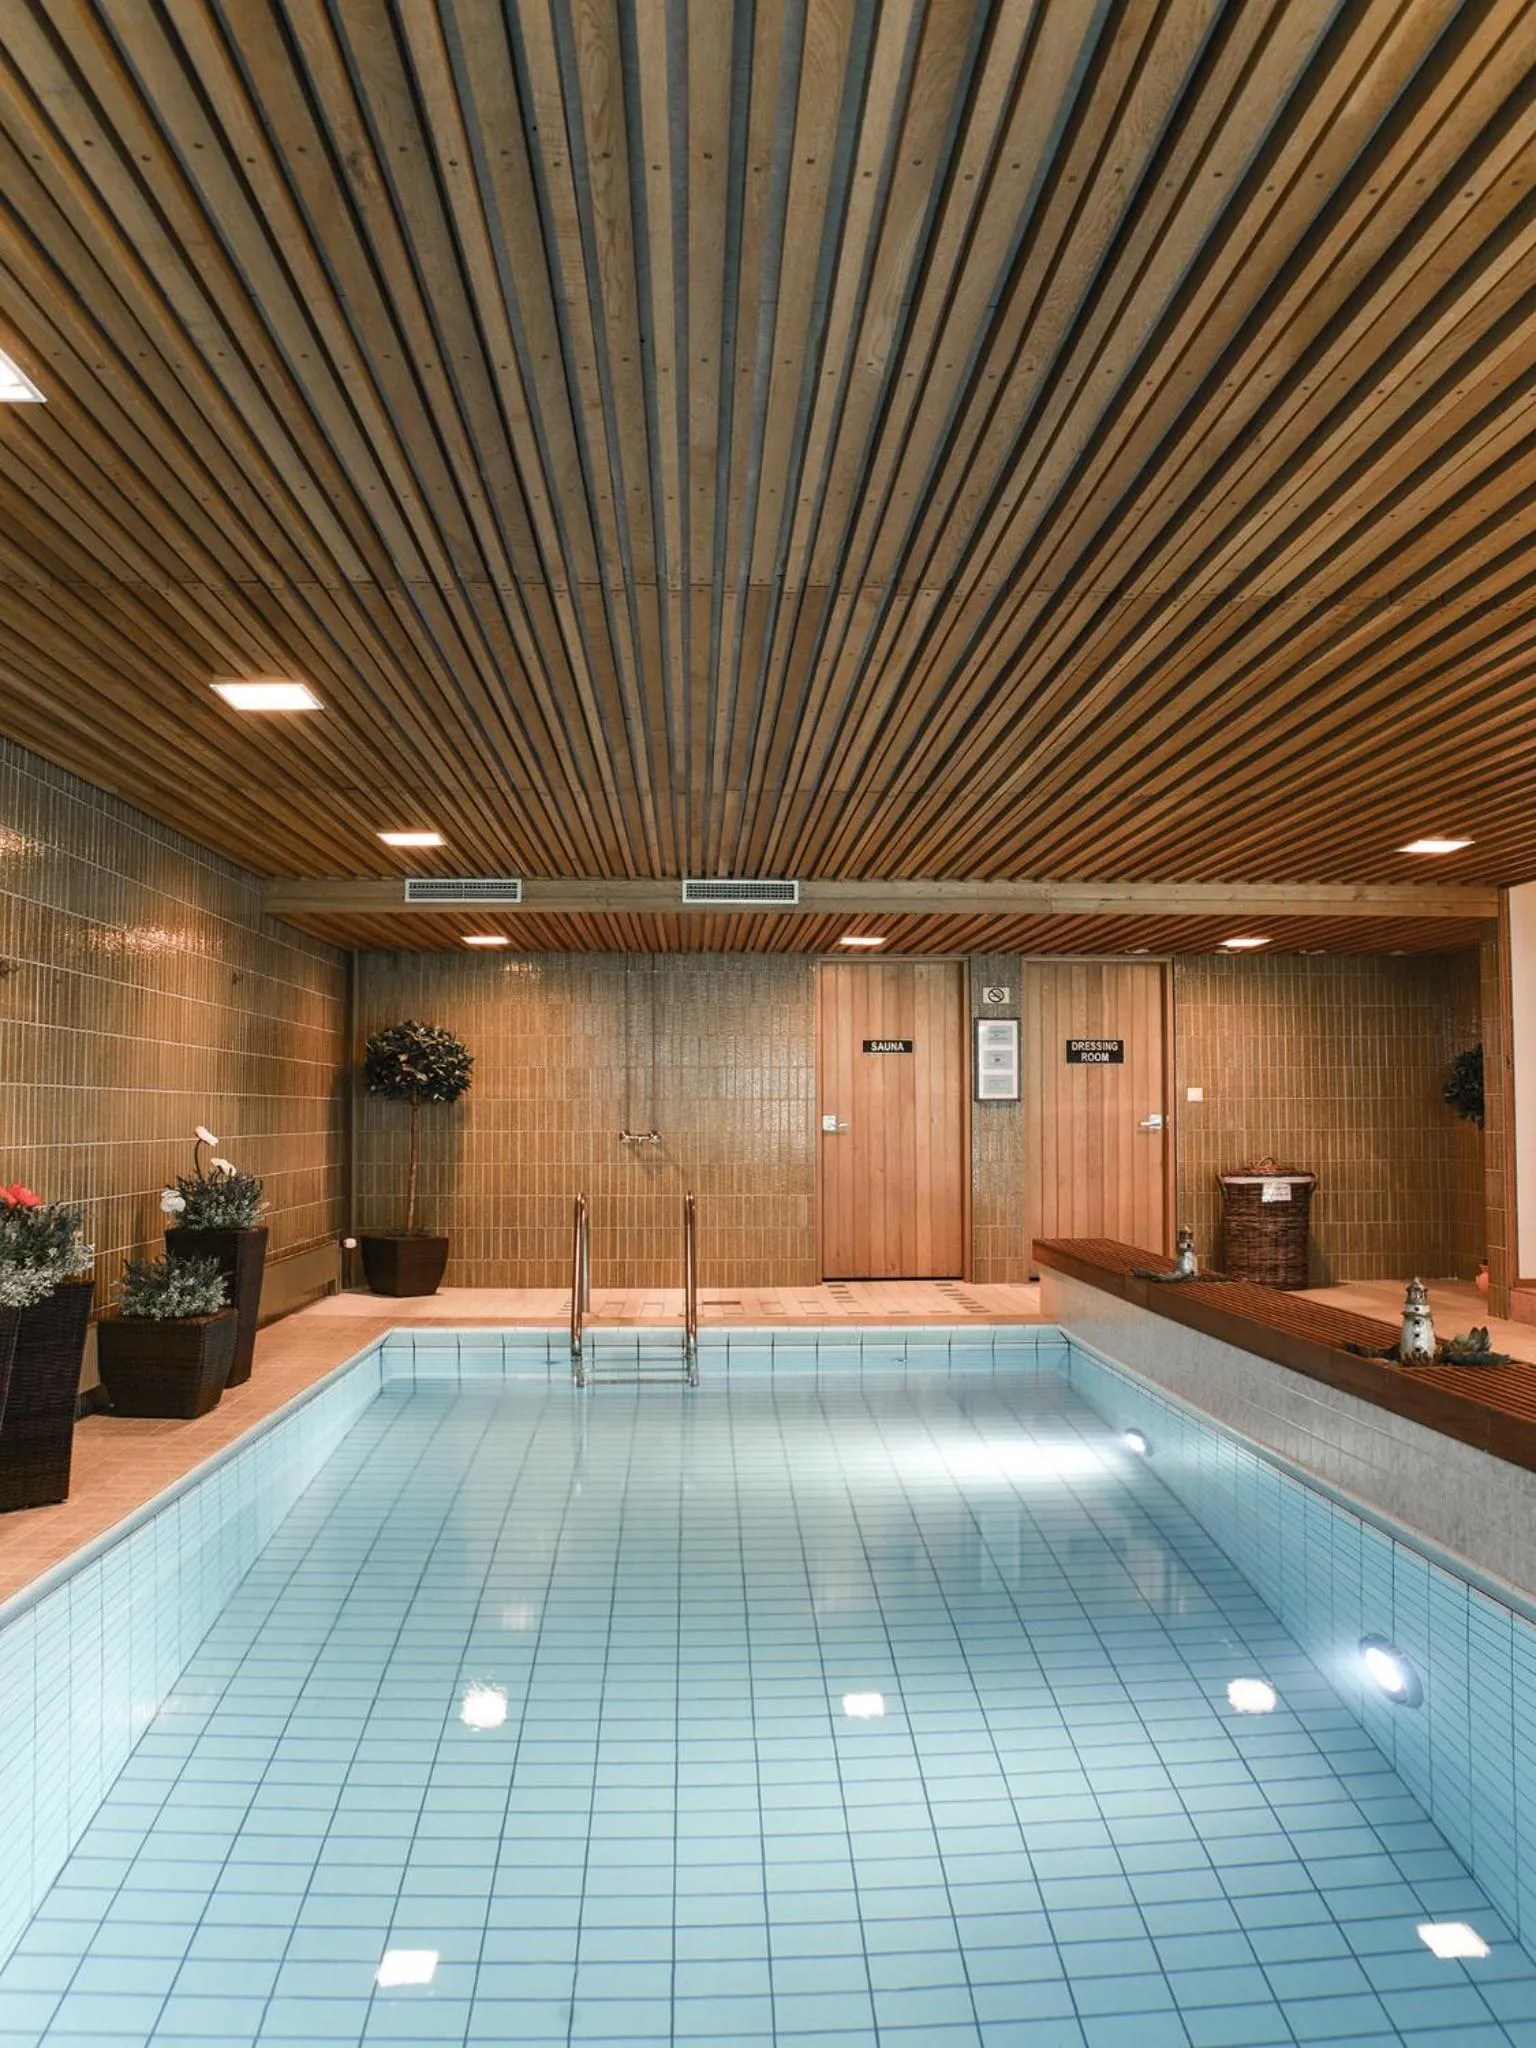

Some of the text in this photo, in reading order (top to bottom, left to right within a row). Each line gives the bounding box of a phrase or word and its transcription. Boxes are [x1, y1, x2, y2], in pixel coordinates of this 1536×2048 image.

[871, 1041, 904, 1051] SAUNA
[1071, 1041, 1119, 1051] DRESSING
[1081, 1052, 1109, 1062] ROOM
